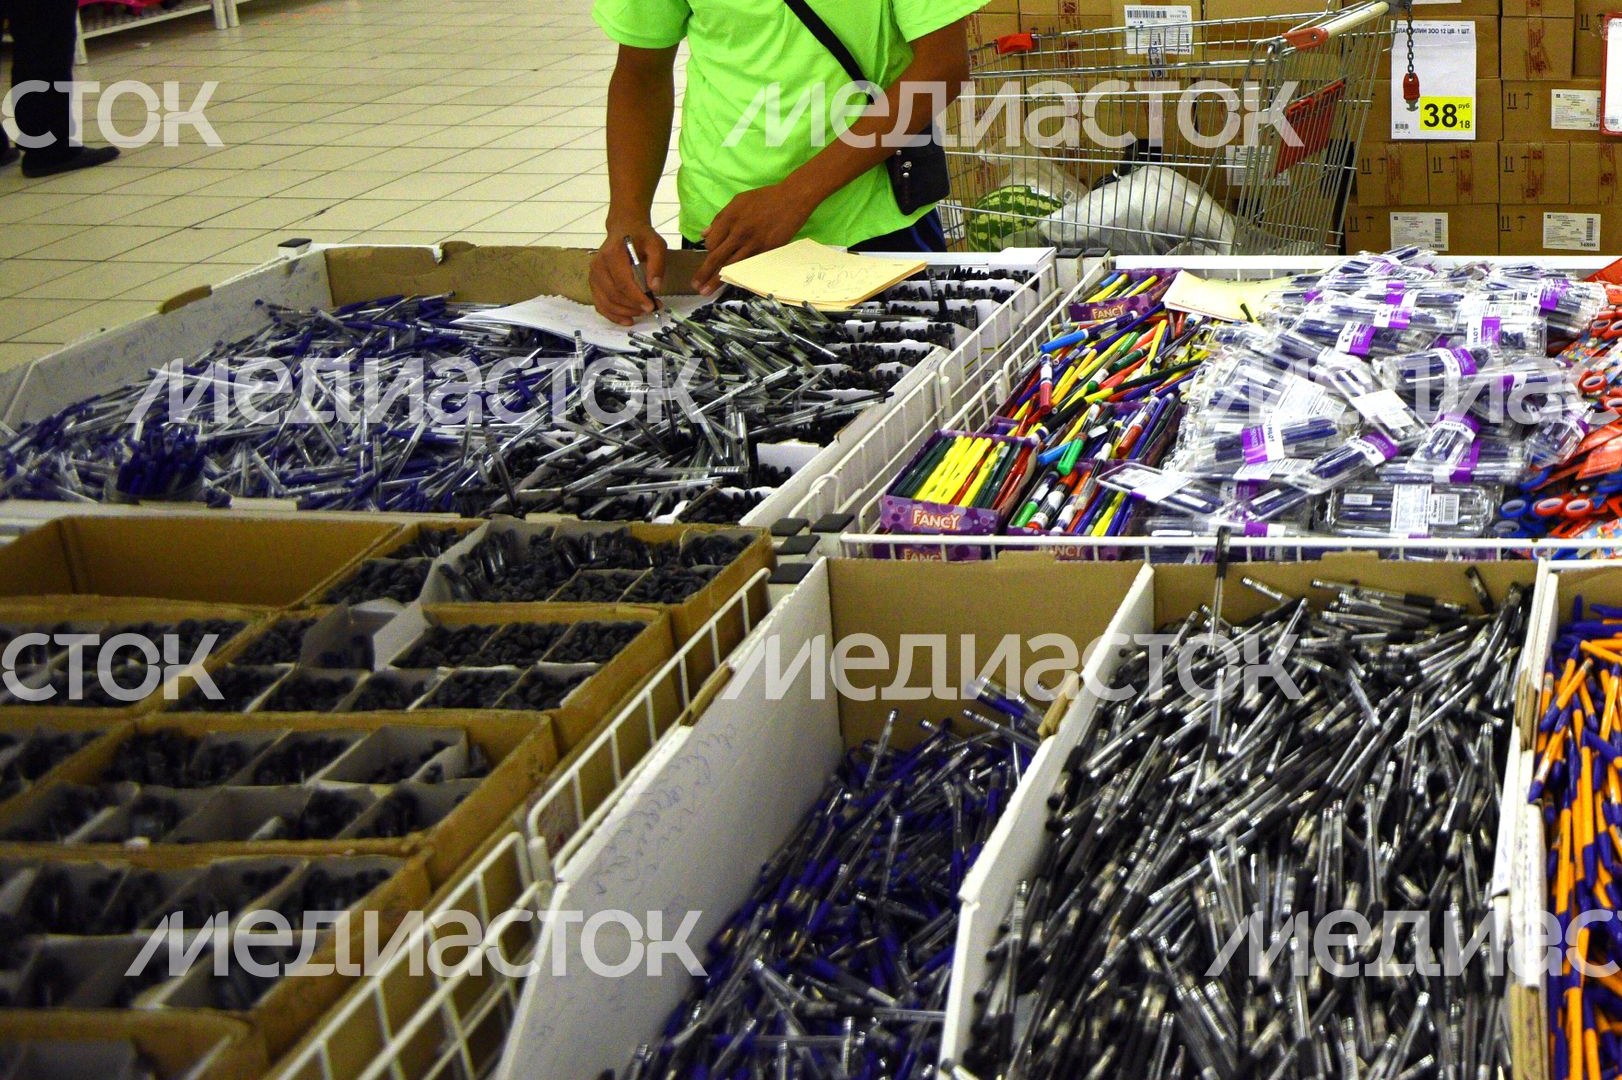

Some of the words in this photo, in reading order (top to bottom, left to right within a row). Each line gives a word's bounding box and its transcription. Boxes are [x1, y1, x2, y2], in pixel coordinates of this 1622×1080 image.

[1424, 103, 1457, 128] 38
[1459, 120, 1470, 129] 18
[1091, 304, 1126, 320] FANCY
[912, 508, 961, 530] FANCY
